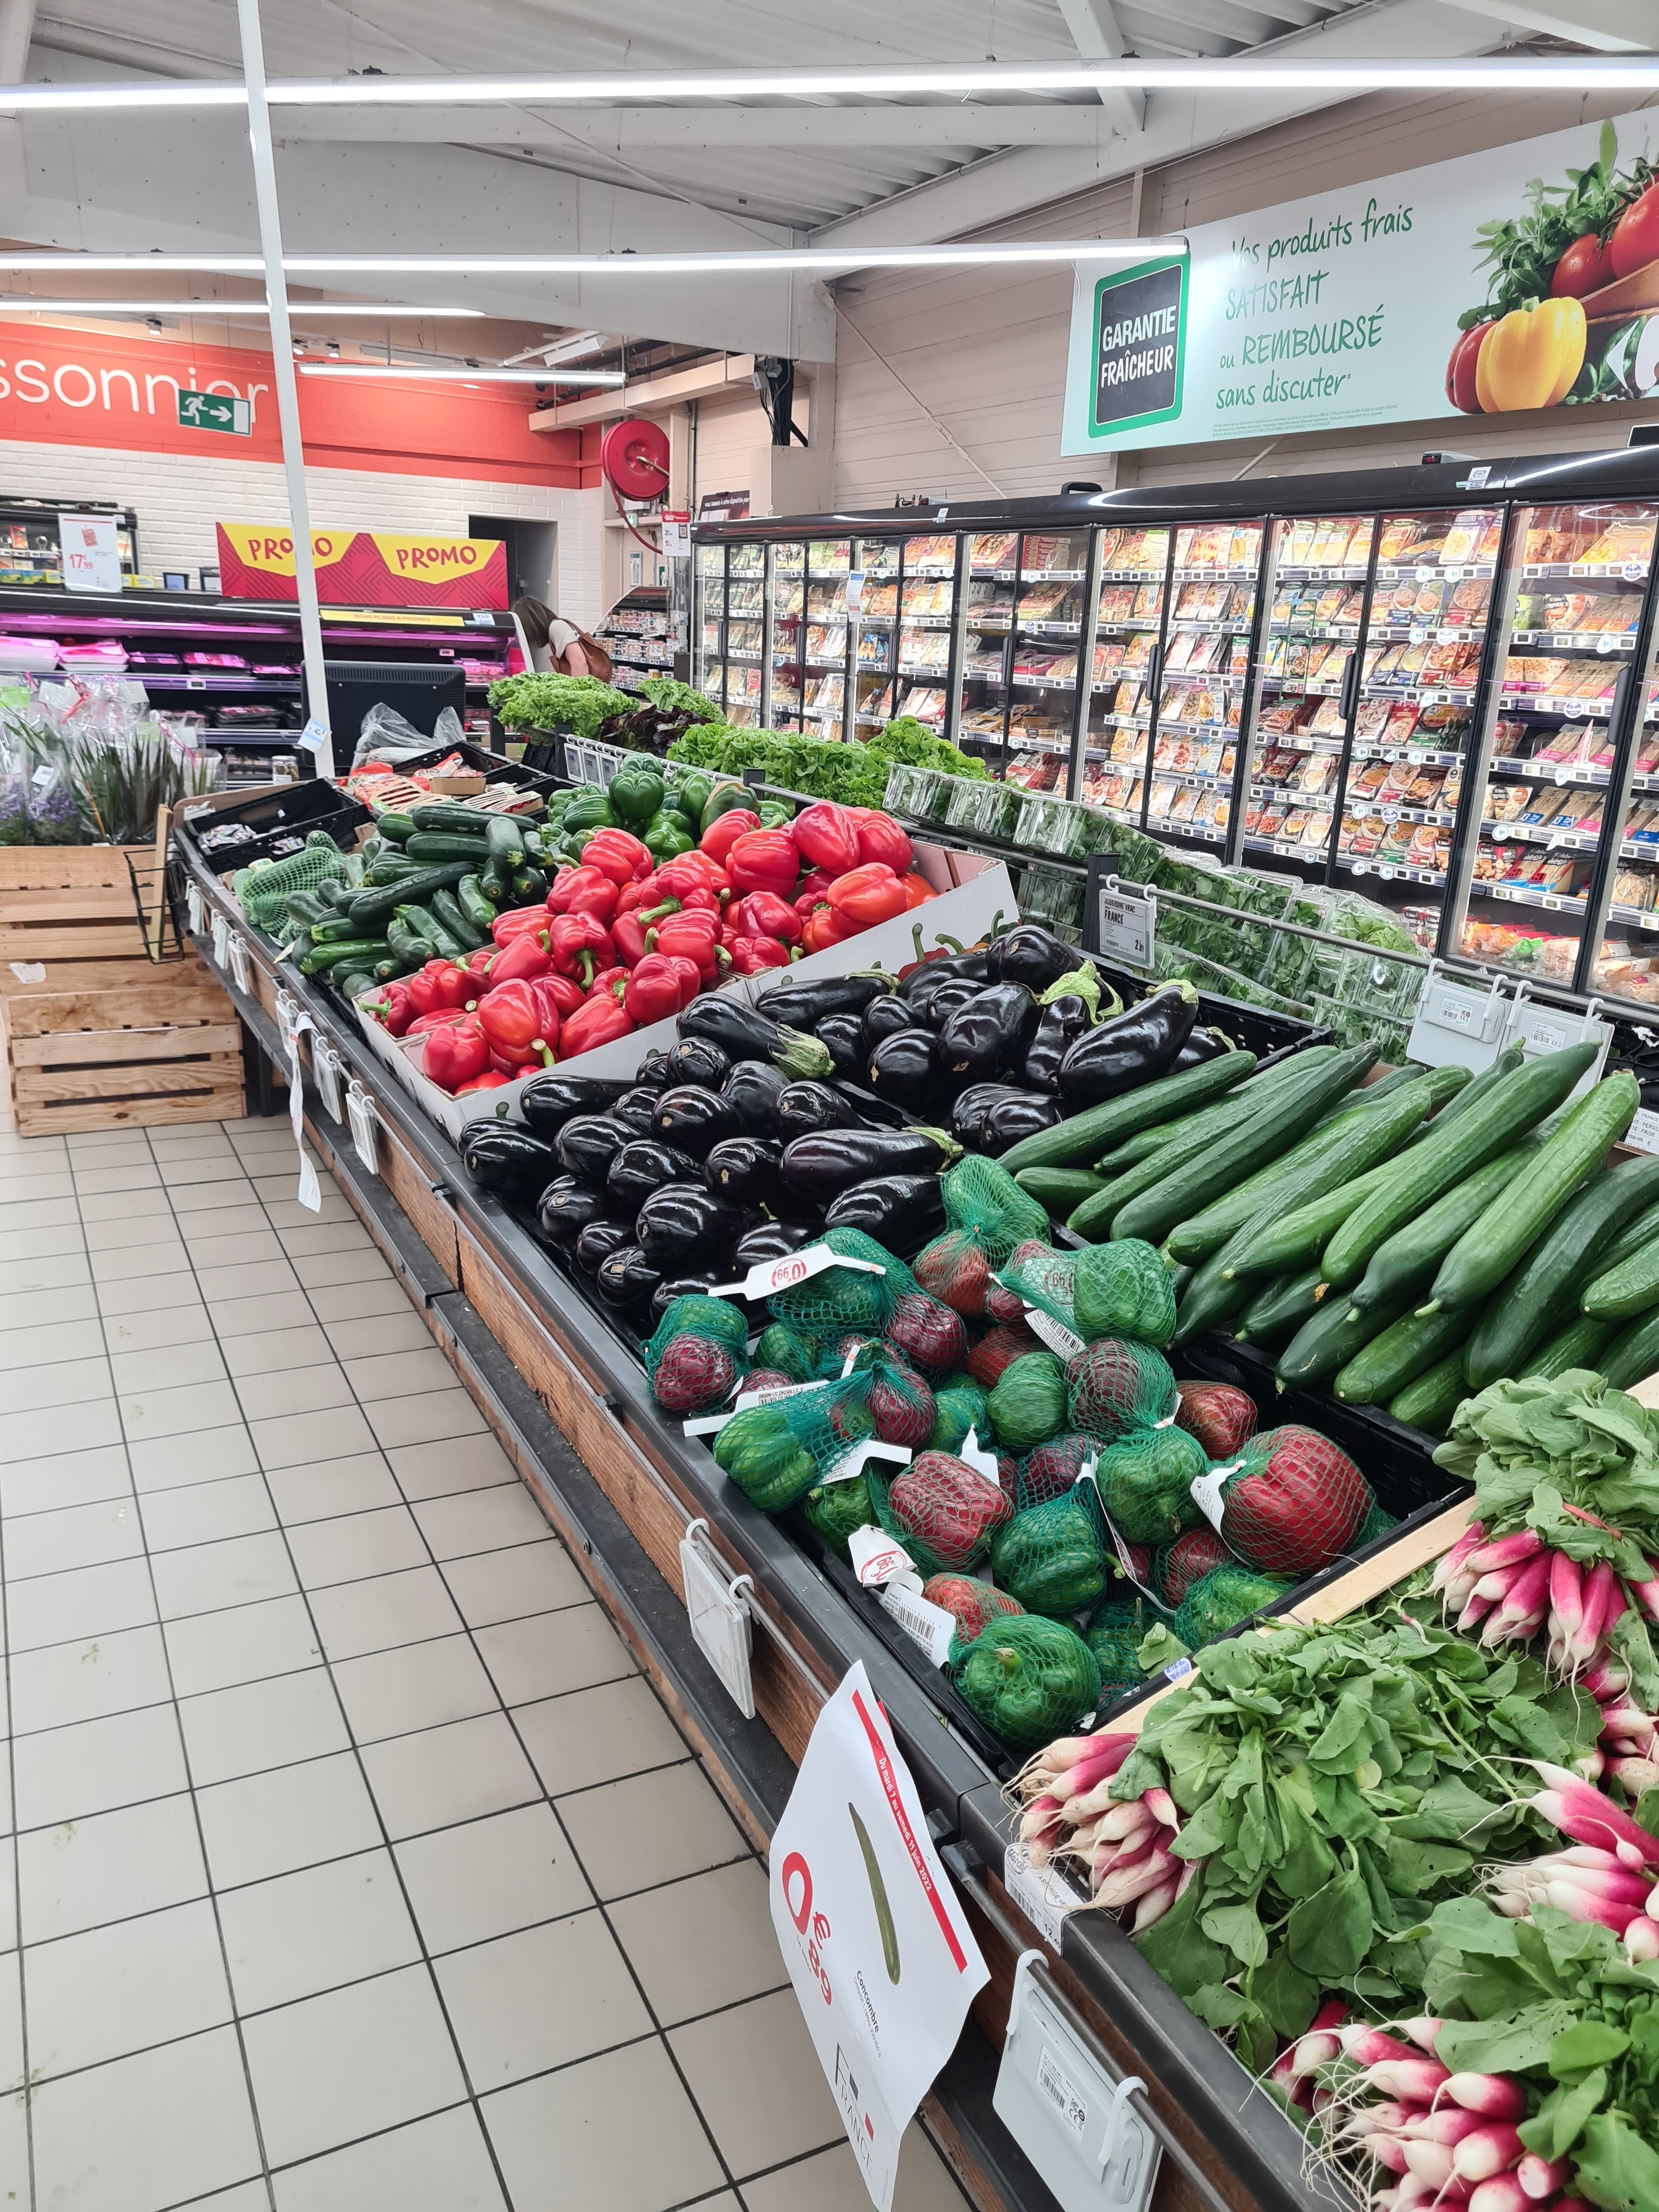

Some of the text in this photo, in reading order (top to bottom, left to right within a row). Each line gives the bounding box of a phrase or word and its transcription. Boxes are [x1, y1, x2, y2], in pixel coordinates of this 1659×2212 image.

[1232, 198, 1413, 273] Vos produits frais
[1226, 269, 1330, 320] SATISFAIT
[1102, 305, 1177, 352] GARANTIE
[1220, 303, 1385, 369] ou REMBOURSÉ
[1101, 345, 1174, 388] FRAÎCHEUR
[1216, 385, 1256, 409] sans
[247, 537, 333, 561] PROO
[396, 545, 477, 570] PROMO
[1104, 898, 1136, 913] AUBERGINE VRAC
[1104, 910, 1124, 925] FRANCE
[1642, 1113, 1659, 1122] FRANCE
[1641, 1128, 1656, 1137] FRISE
[879, 1756, 887, 1770] Du
[882, 1769, 895, 1793] mardi
[892, 1800, 899, 1811] au
[896, 1810, 911, 1841] samedi
[909, 1839, 915, 1852] 11
[911, 1849, 921, 1868] juin
[919, 1866, 932, 1892] 2022
[857, 1970, 879, 2033] Concombre
[835, 2041, 873, 2179] FRANCE
